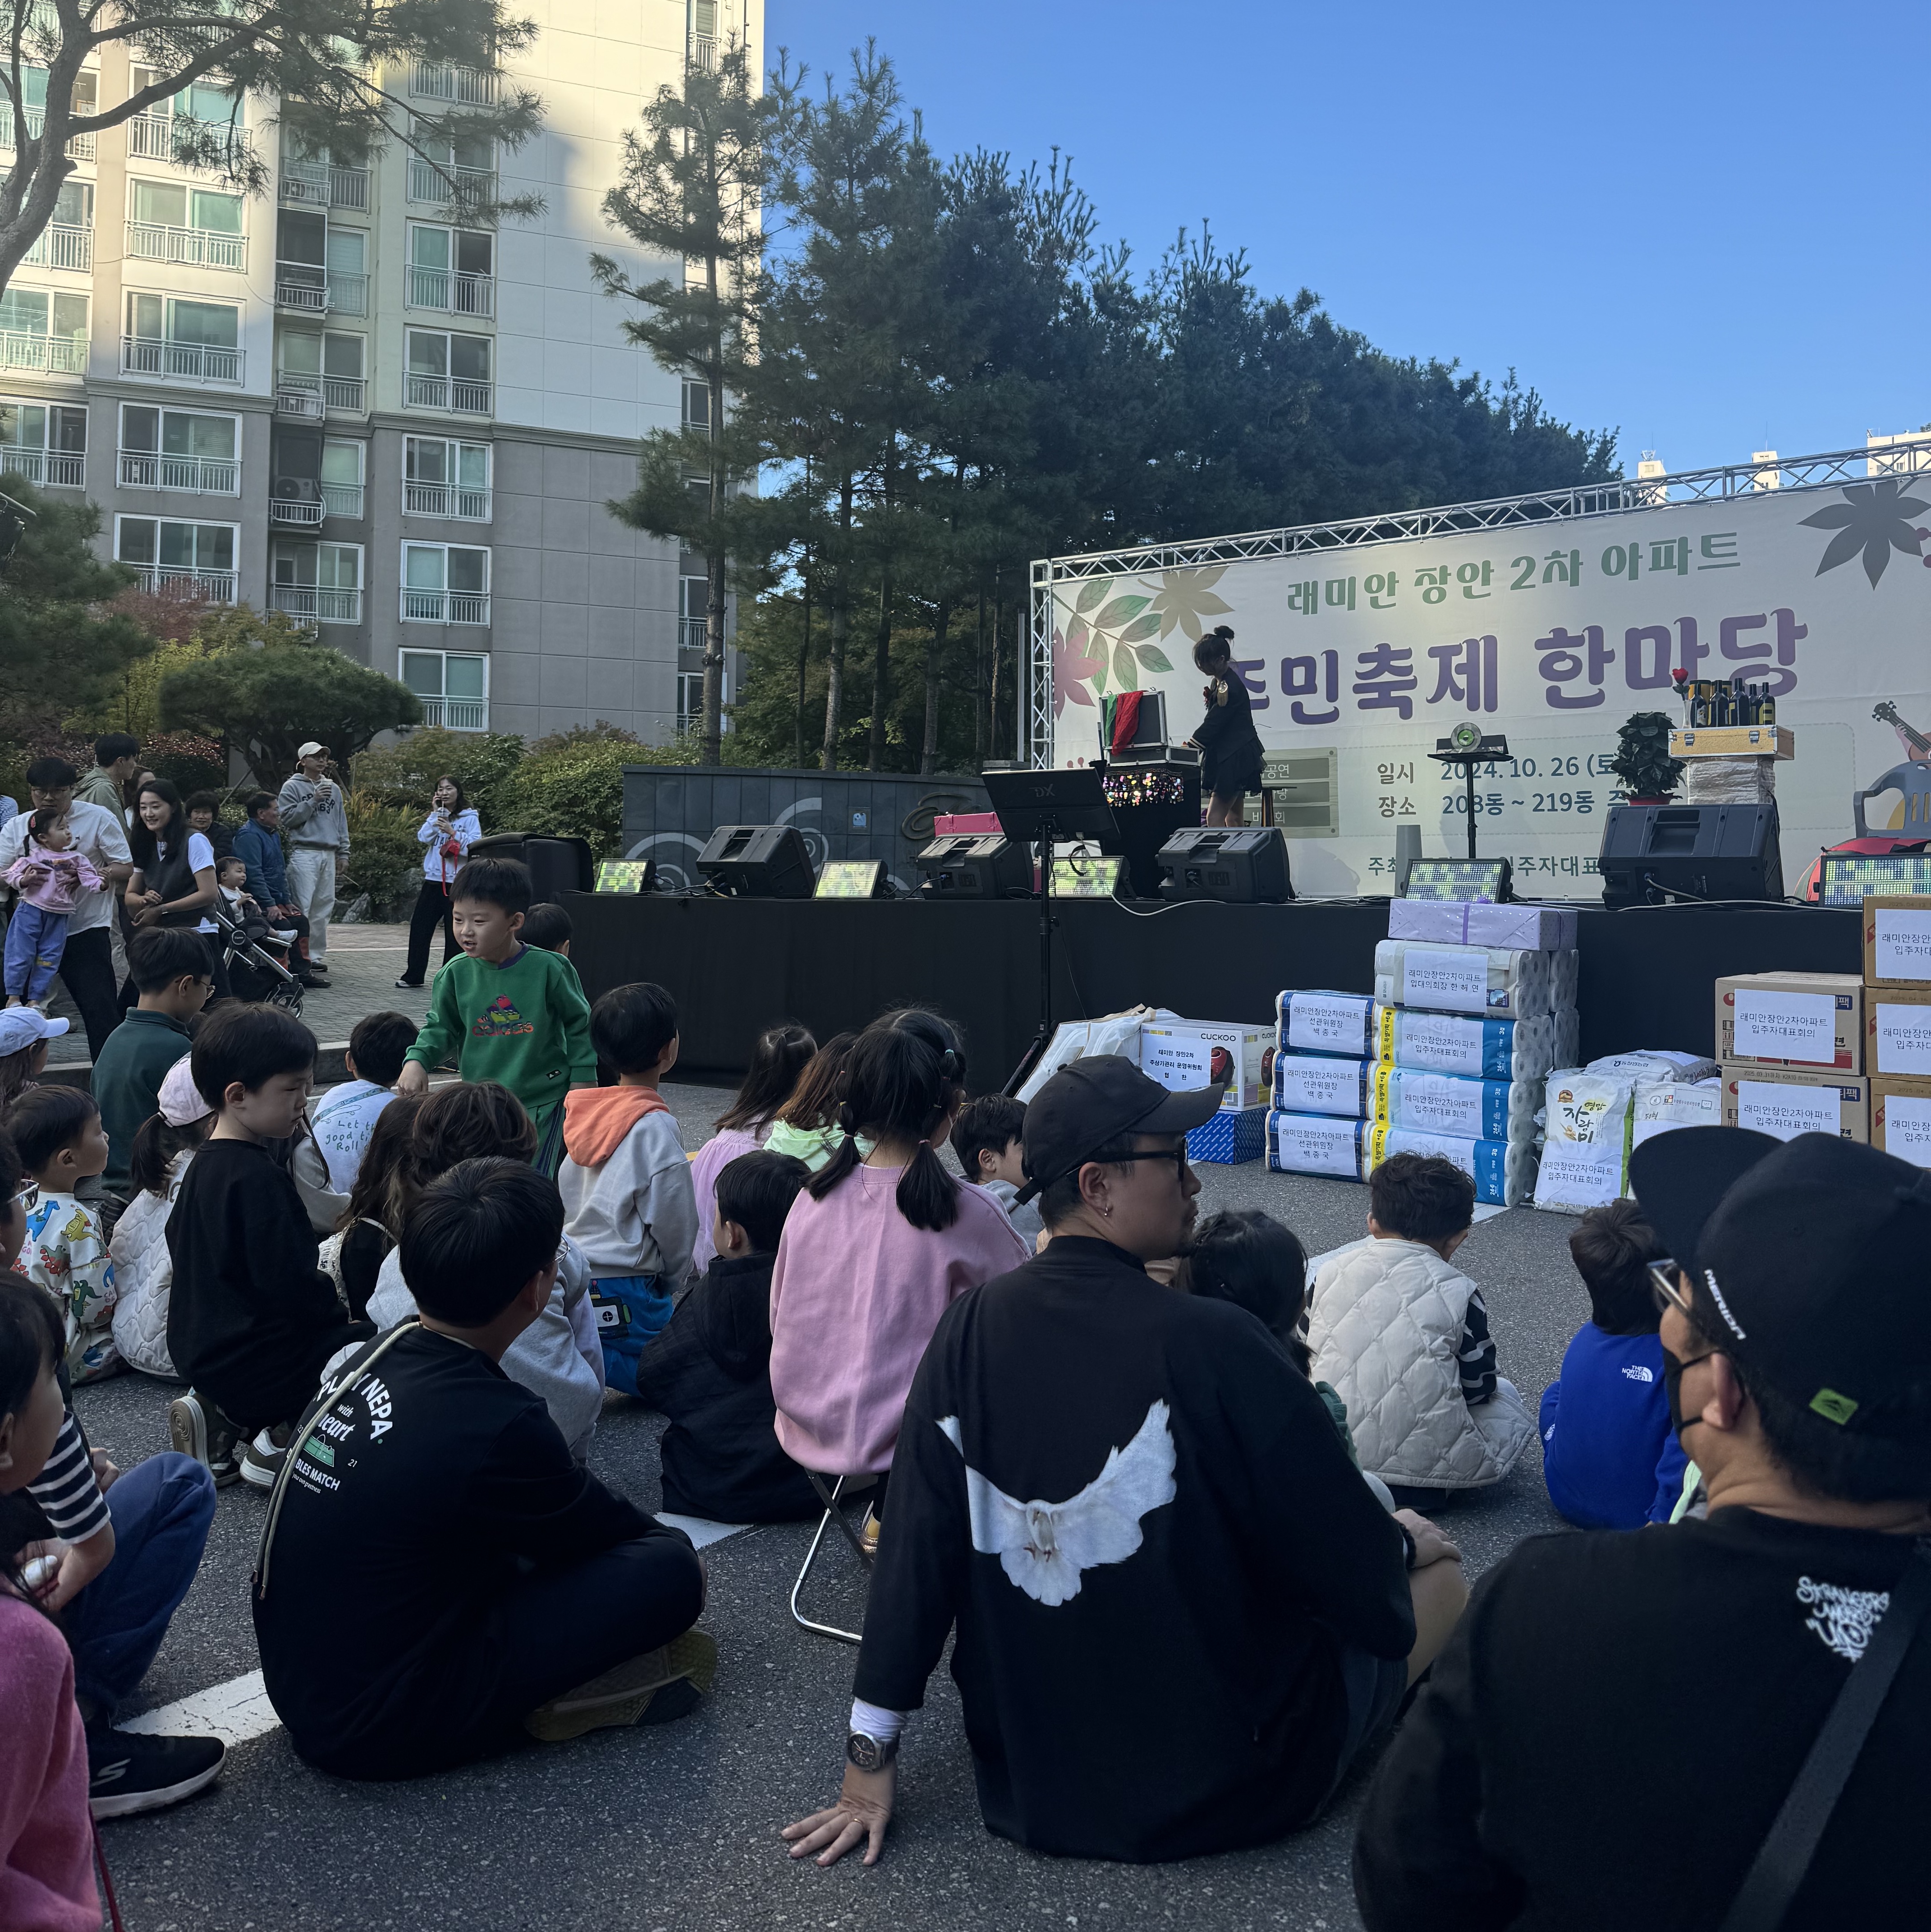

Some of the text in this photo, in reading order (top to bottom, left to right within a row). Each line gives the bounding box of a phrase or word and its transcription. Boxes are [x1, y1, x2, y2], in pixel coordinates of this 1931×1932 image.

[1287, 532, 1741, 615] 래미안 장안 2차 아파트
[1534, 608, 1808, 709] 한마당
[1377, 762, 1414, 784] 일시
[1550, 757, 1579, 777] 26
[1378, 796, 1417, 818] 장소
[1408, 969, 1481, 982] 래미안장안2차아파트
[1450, 983, 1458, 991] 한
[1294, 1006, 1360, 1019] 래미안장안2차아파트
[1309, 1018, 1343, 1028] 선관위원장
[1740, 1012, 1828, 1027] 래미안장안2차아파트
[472, 1021, 534, 1037] adidas
[1752, 1025, 1815, 1038] 입주자대표회의
[1201, 1033, 1236, 1042] CUCKOO
[1406, 1033, 1477, 1049] 래미안장안2차아파트
[1415, 1045, 1467, 1059] 입주자대표회의
[1288, 1070, 1354, 1080] 래미안장안2차아파트
[1303, 1081, 1337, 1090] 선관위원장
[1405, 1094, 1477, 1109] 래미안장안2차아파트
[1584, 1101, 1606, 1111] 영암
[1415, 1105, 1467, 1119] 입주자대표회의
[1744, 1105, 1833, 1120] 래미안장안2차아파트
[338, 1120, 359, 1129] Let
[1756, 1117, 1820, 1131] 입주자대표회의
[325, 1131, 353, 1145] good
[1283, 1129, 1349, 1141] 래미안장안2차아파트
[337, 1140, 358, 1152] Roll
[1299, 1140, 1333, 1150] 선관위원장
[1543, 1161, 1614, 1175] 래미안장안2차아파트
[1548, 1172, 1602, 1185] 입주자대표회의
[337, 1404, 354, 1417] with
[361, 1378, 393, 1440] NEPA
[348, 1459, 358, 1468] 21
[309, 1468, 340, 1491] MATCH
